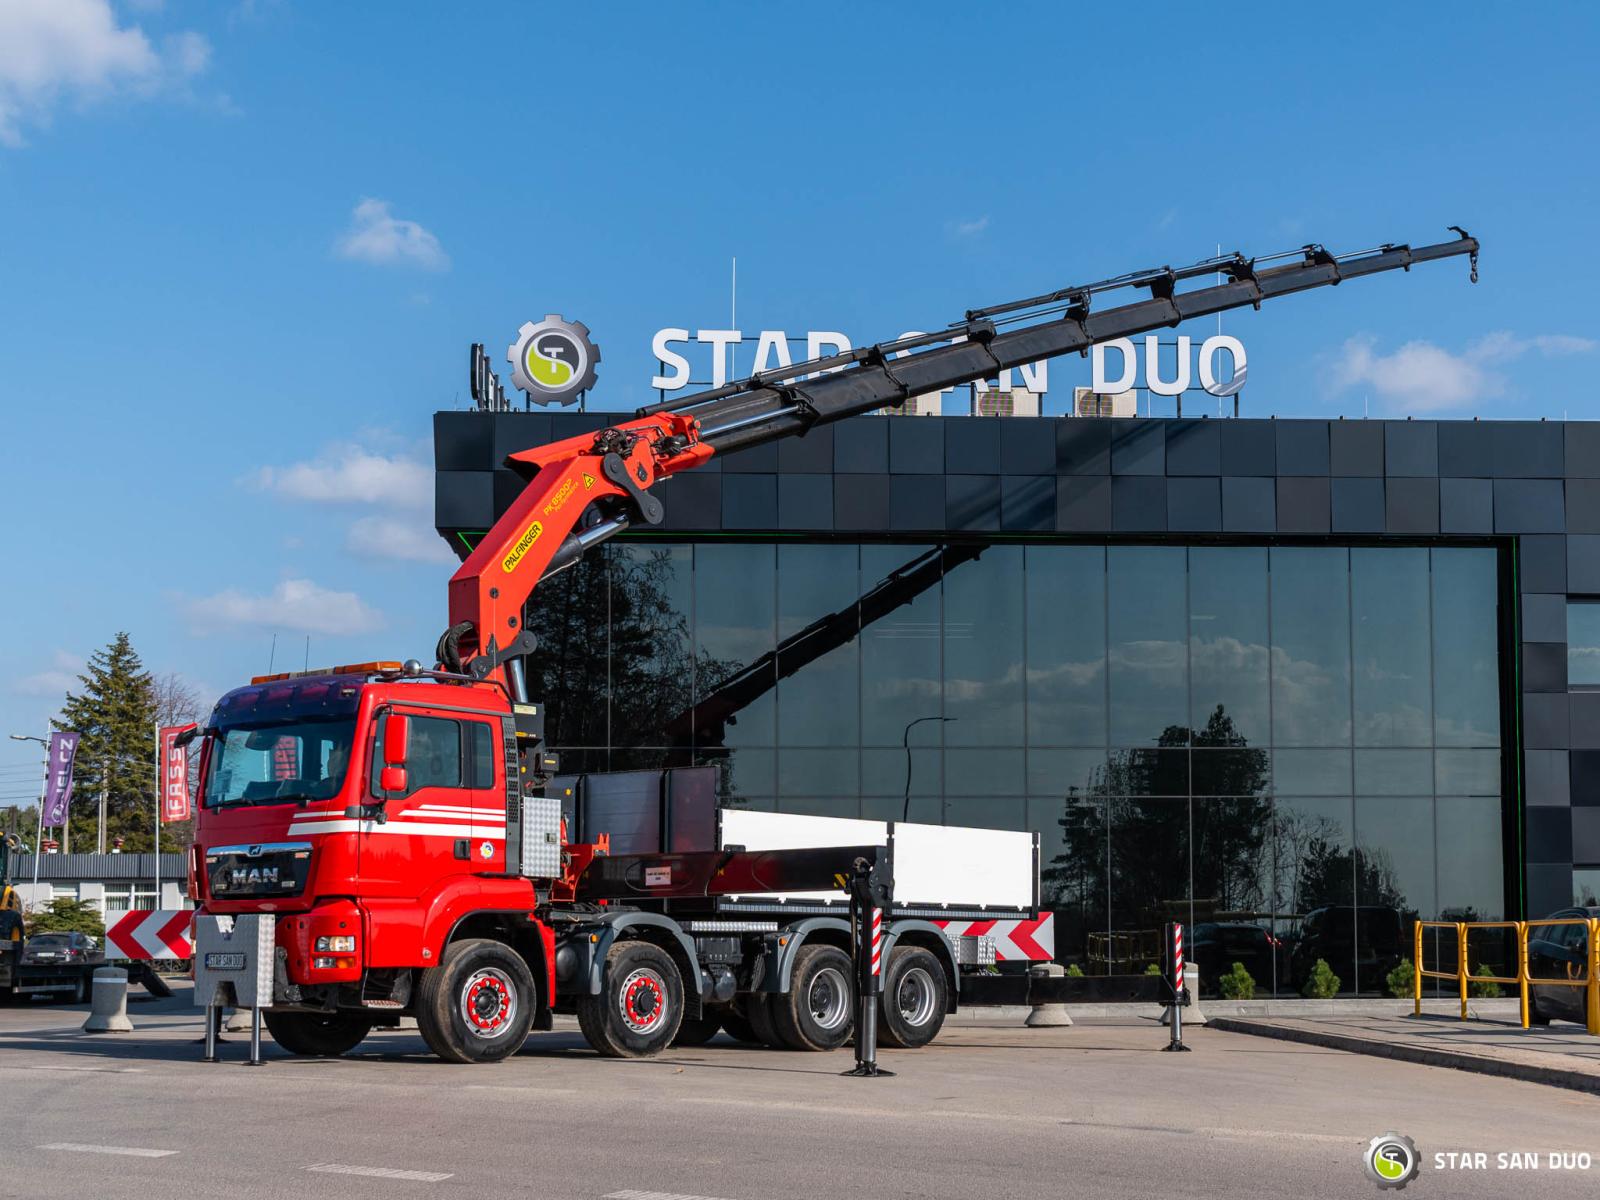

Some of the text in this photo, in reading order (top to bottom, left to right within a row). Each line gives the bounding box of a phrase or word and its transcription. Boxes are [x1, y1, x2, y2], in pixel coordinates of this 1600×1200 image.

[1092, 333, 1248, 396] DUO
[504, 523, 541, 570] PALFINGER
[232, 867, 279, 884] MAN
